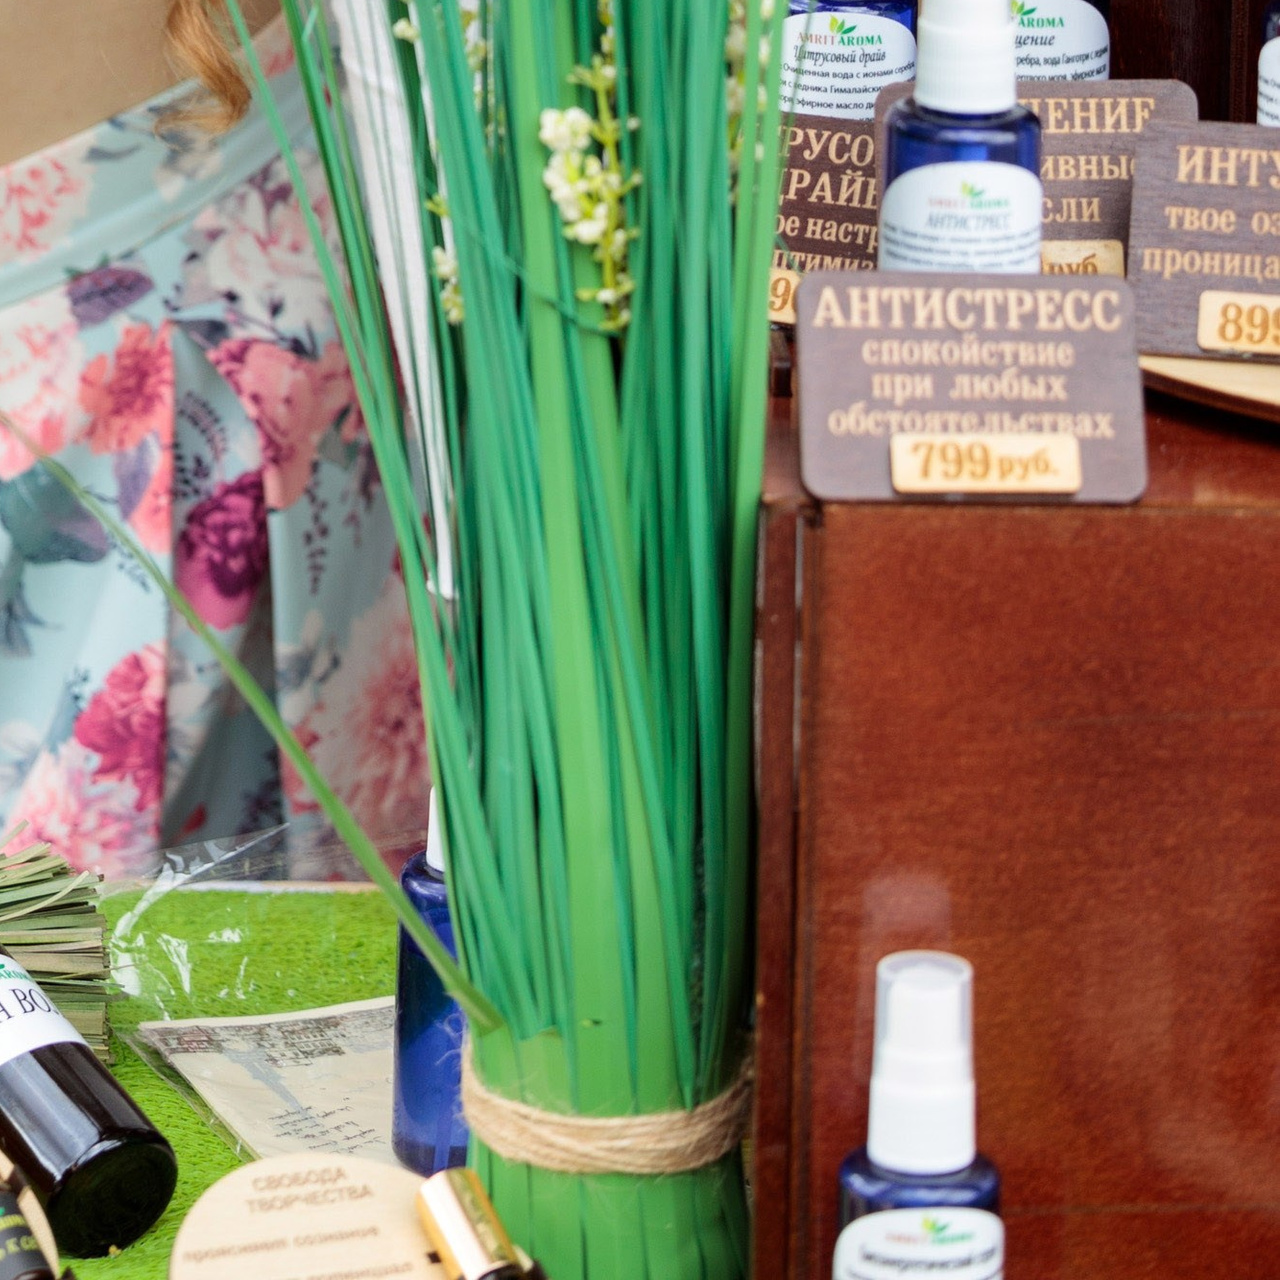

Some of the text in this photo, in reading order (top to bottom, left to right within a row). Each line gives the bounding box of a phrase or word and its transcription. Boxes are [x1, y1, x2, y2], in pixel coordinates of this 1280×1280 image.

[778, 124, 876, 167] РУСО
[1040, 197, 1101, 223] сли
[805, 217, 878, 253] настр
[1142, 247, 1280, 282] проница
[813, 286, 1121, 332] АНТИСТРЕСС
[861, 332, 1075, 367] спокойствие
[871, 367, 1068, 406] при любых
[911, 441, 991, 481] 799
[9, 988, 59, 1016] ВО
